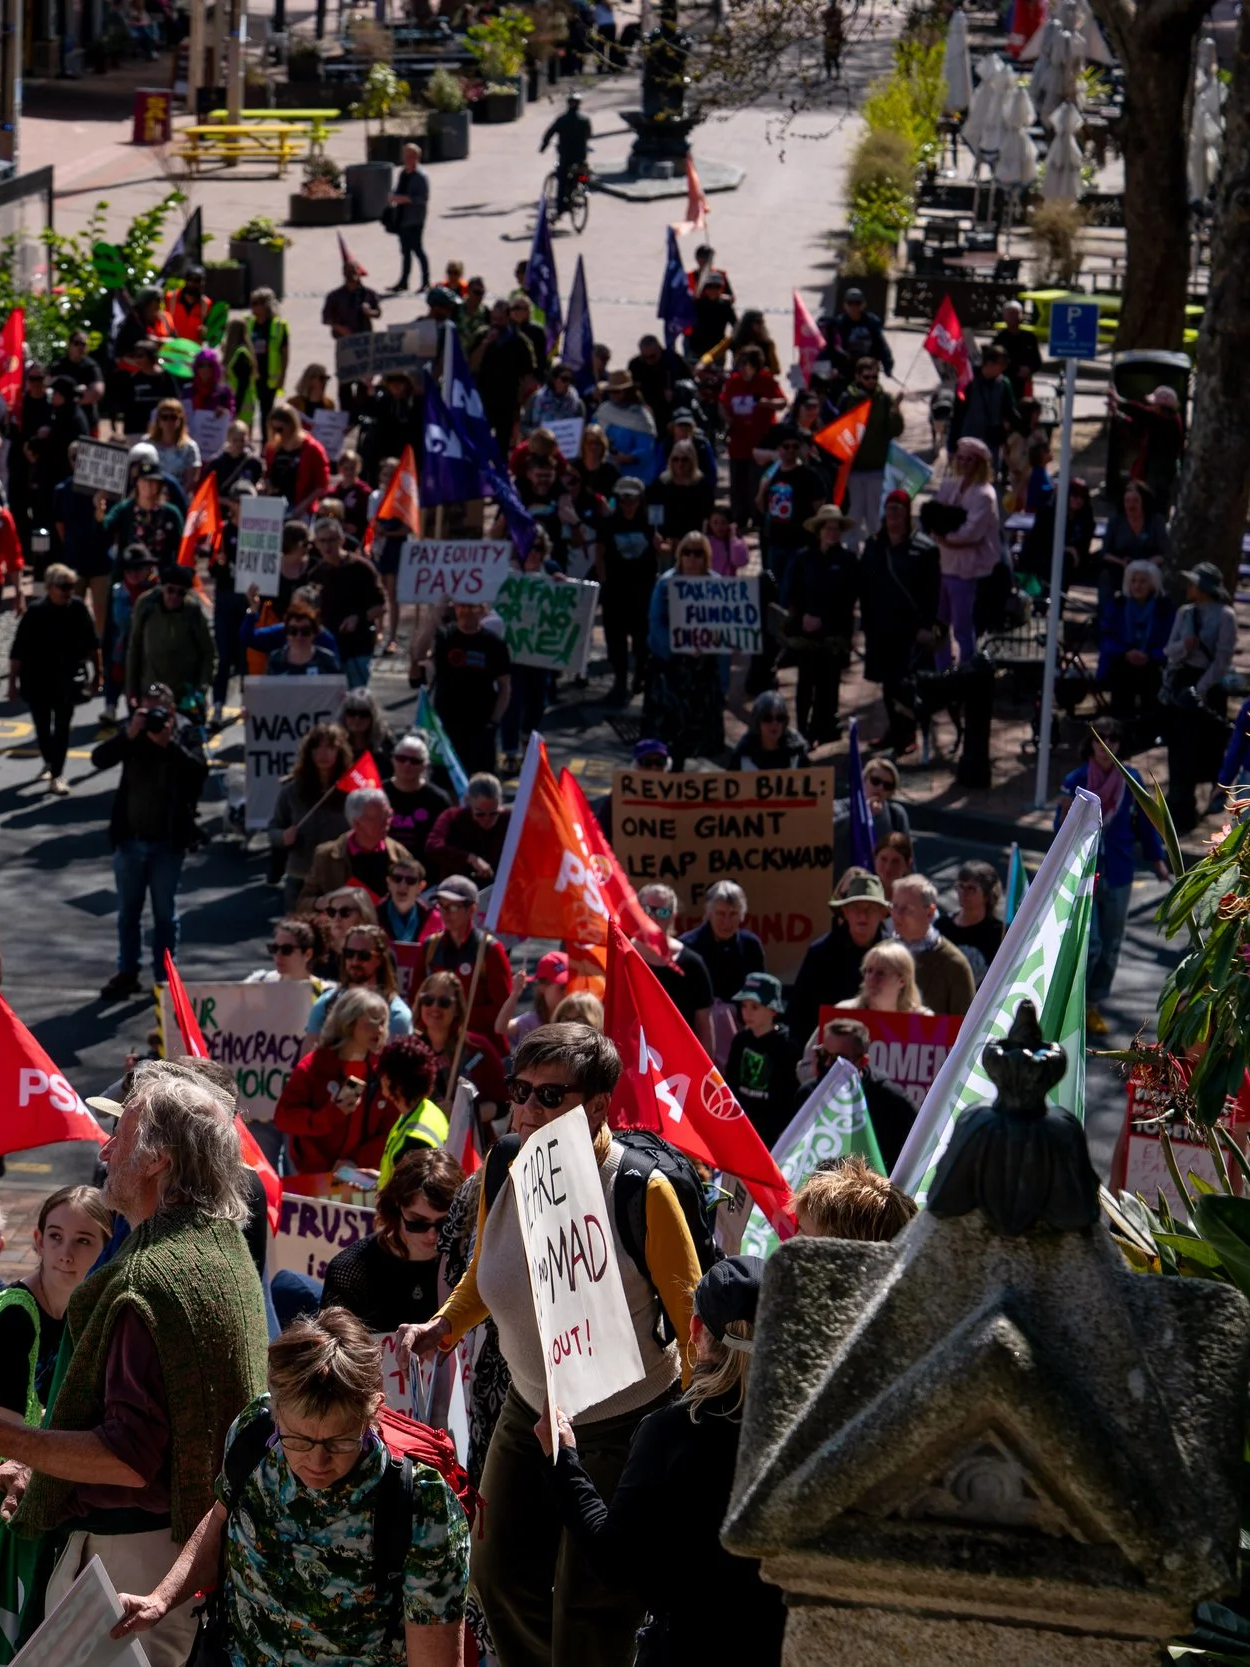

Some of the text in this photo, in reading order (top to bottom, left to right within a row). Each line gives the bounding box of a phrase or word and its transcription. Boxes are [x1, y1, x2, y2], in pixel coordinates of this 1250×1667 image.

[1066, 306, 1082, 324] P
[409, 544, 505, 565] PAY EQUITY
[414, 567, 484, 595] PAYS
[621, 775, 827, 802] REVISED BILL:
[621, 811, 786, 841] ONE GIANT
[627, 850, 698, 879] LEAP
[530, 1138, 568, 1215] ARE
[279, 1200, 376, 1249] TRUST
[546, 1214, 609, 1304] MAD
[552, 1318, 593, 1366] OUT!
